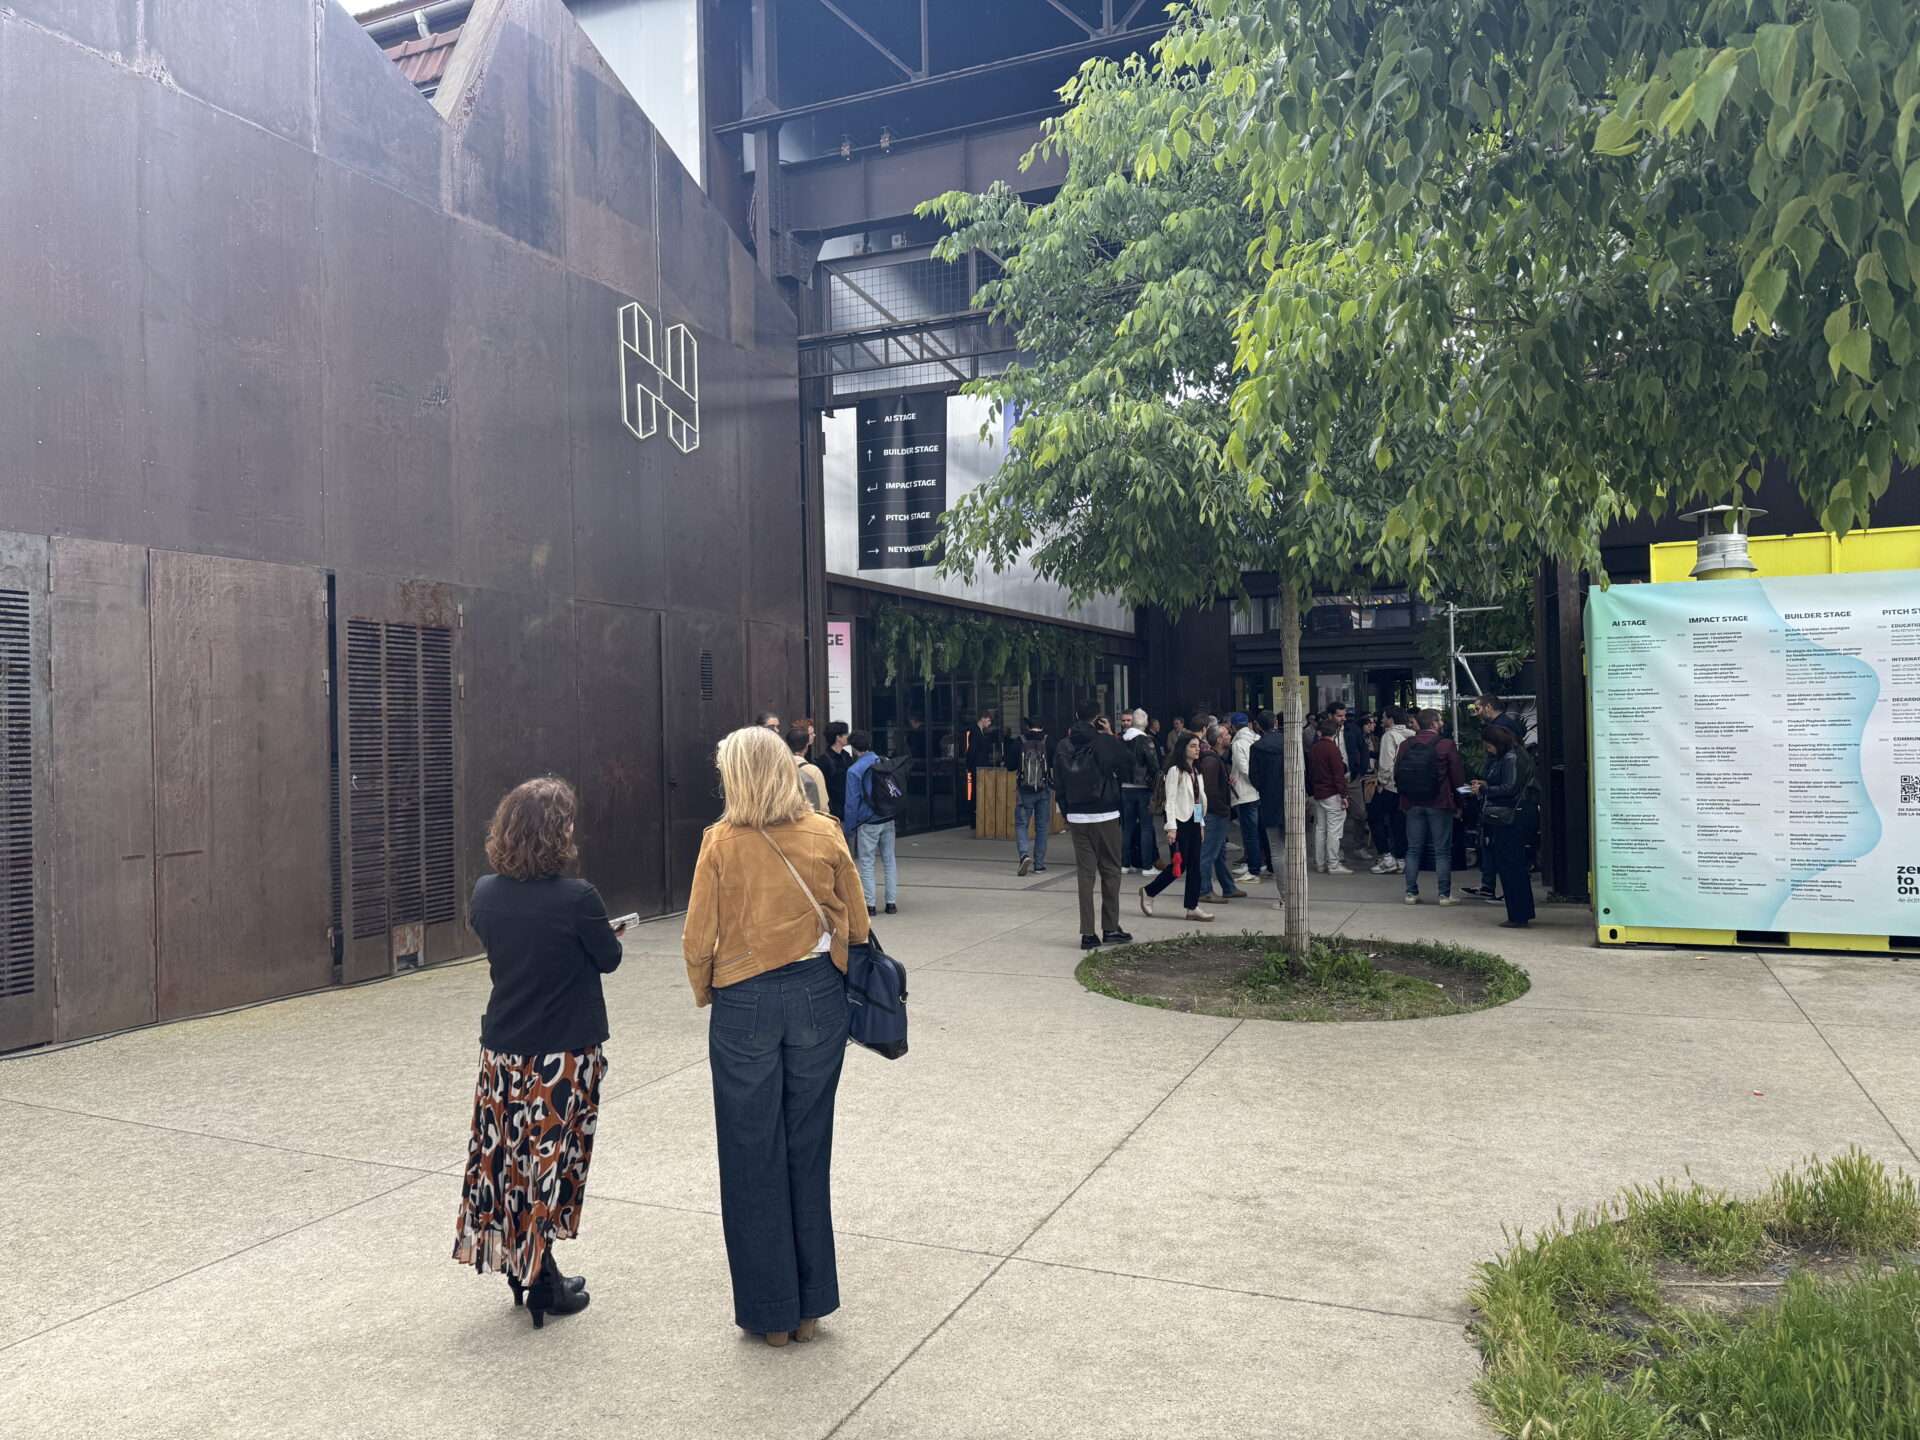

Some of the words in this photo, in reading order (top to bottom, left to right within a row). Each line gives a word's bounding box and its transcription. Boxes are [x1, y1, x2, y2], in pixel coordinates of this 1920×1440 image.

[893, 413, 916, 421] STAGE
[883, 447, 914, 456] BUILDER
[914, 444, 939, 453] STAGE
[885, 481, 912, 489] IMPACT
[913, 479, 936, 487] STAGE
[910, 511, 931, 520] STAGE
[1784, 612, 1822, 620] BUILDER
[1882, 608, 1909, 616] PITCH
[1621, 619, 1647, 627] STAGE
[1897, 875, 1914, 885] to
[1898, 886, 1920, 895] on
